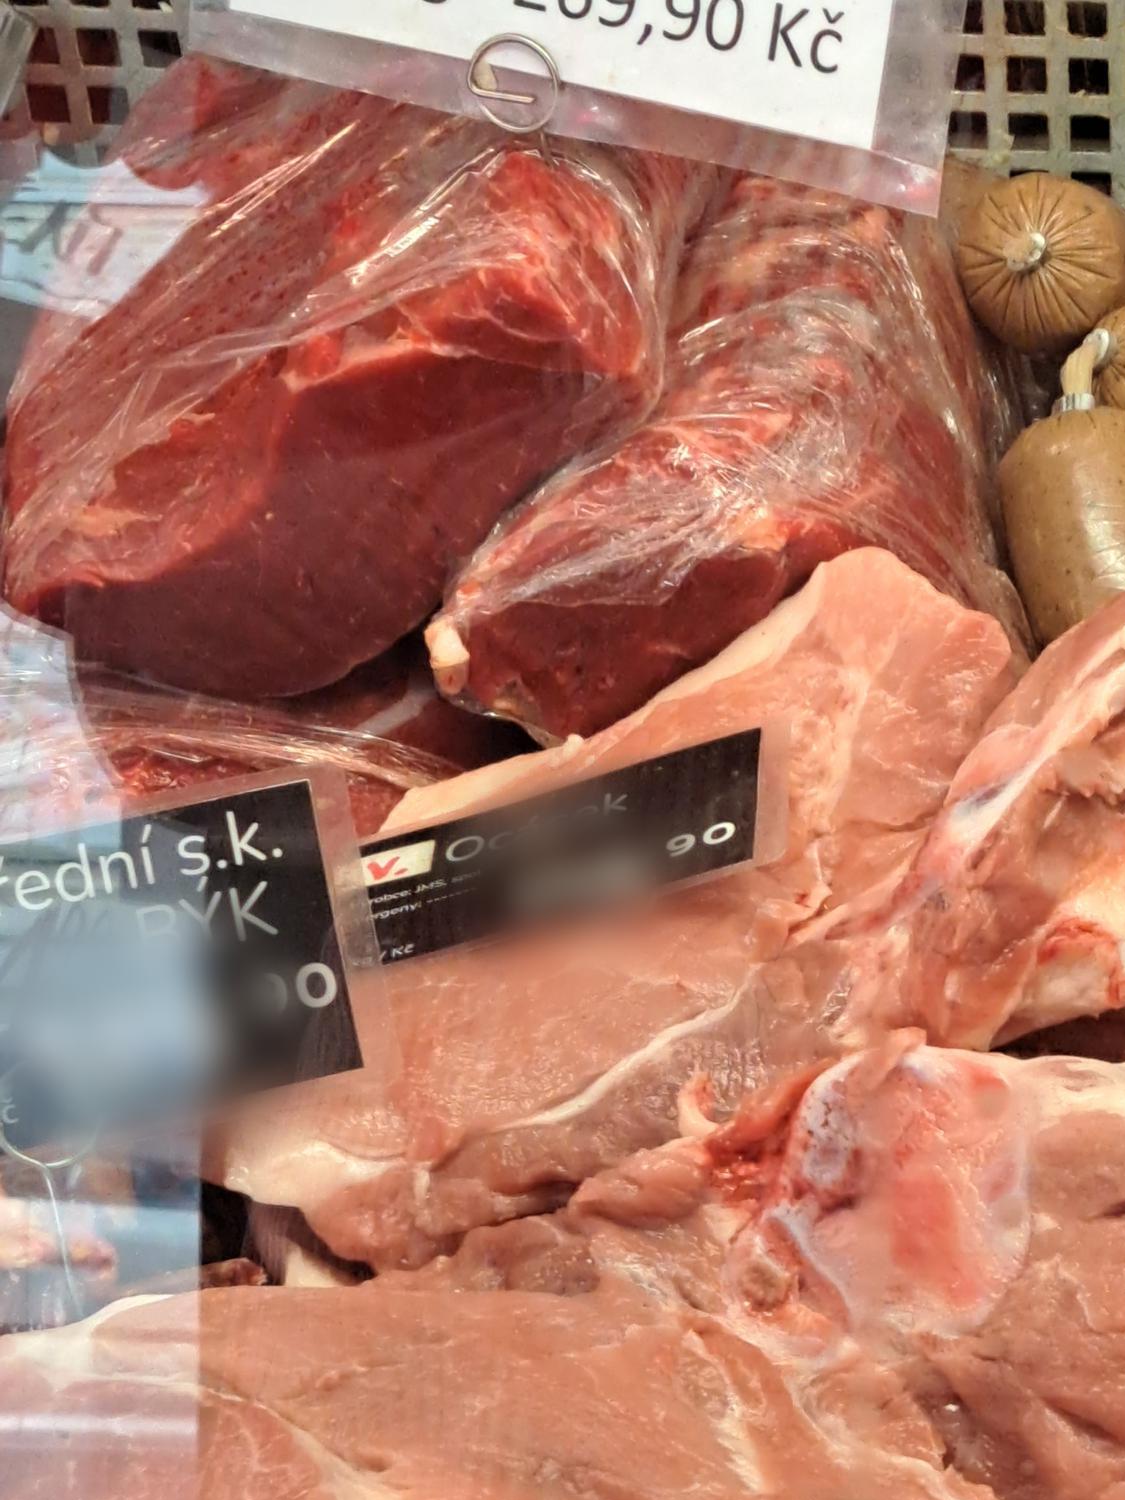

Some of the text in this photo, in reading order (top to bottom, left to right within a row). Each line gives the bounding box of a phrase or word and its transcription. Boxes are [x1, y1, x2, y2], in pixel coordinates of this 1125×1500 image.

[766, 3, 845, 74] Kč
[178, 810, 284, 876] s.k.
[665, 821, 737, 859] 90
